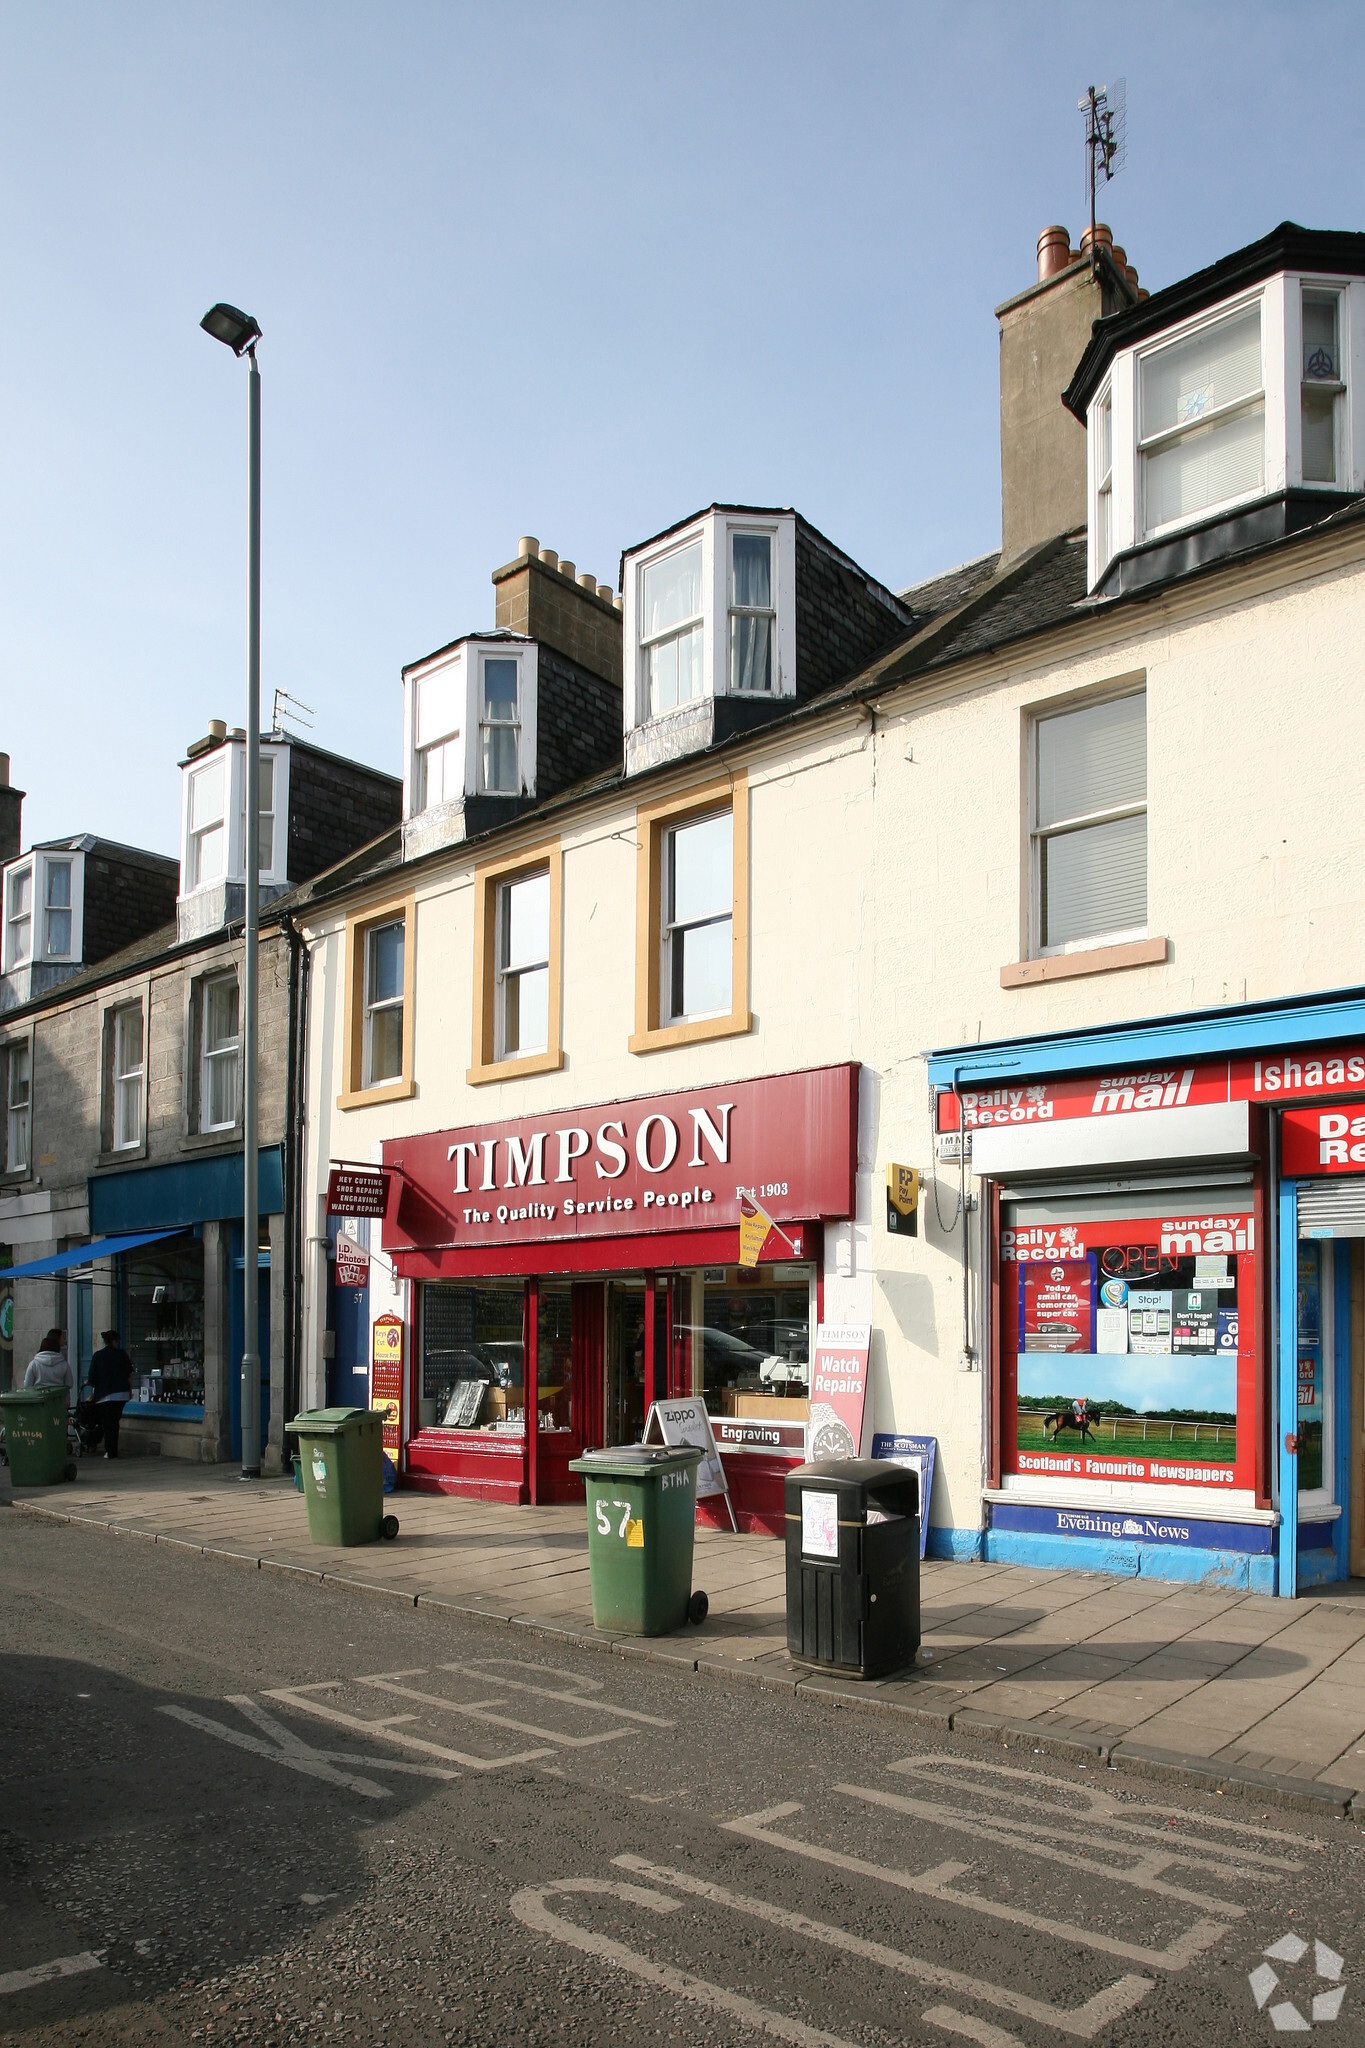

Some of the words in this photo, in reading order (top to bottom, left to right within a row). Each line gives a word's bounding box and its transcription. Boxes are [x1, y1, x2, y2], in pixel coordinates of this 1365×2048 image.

[1100, 1072, 1175, 1088] sunday
[1255, 1056, 1364, 1091] Ishaas
[962, 1090, 1022, 1108] Daily
[1092, 1069, 1195, 1112] mail
[964, 1101, 1053, 1125] Record
[447, 1103, 734, 1194] TIMPSON
[760, 1183, 788, 1197] 1903
[899, 1186, 908, 1196] Pay
[463, 1208, 490, 1224] The
[497, 1202, 555, 1224] Quality
[564, 1196, 633, 1215] Service
[644, 1186, 712, 1208] People
[899, 1195, 912, 1205] Point
[1162, 1218, 1240, 1231] sunday
[1000, 1229, 1056, 1247] Daily
[1161, 1218, 1254, 1254] mail
[339, 1245, 352, 1253] I.D.
[1000, 1243, 1084, 1261] Record
[339, 1254, 366, 1264] Photos
[1102, 1246, 1178, 1272] OPEN
[1044, 1285, 1070, 1293] Today
[354, 1294, 363, 1304] 57
[1139, 1296, 1162, 1305] Stop!
[1194, 1312, 1212, 1321] forget
[822, 1330, 866, 1339] TIMPSON
[821, 1356, 859, 1373] Watch
[816, 1375, 862, 1396] Repairs
[722, 1426, 780, 1444] Engraving
[1018, 1455, 1081, 1472] Scotland's
[1086, 1459, 1144, 1477] Favourite
[1150, 1463, 1234, 1483] Newspapers
[662, 1469, 689, 1491] BTHA
[596, 1500, 631, 1537] 57
[1056, 1513, 1121, 1537] Evening
[1144, 1520, 1189, 1540] News
[153, 1658, 675, 1798] KEEP
